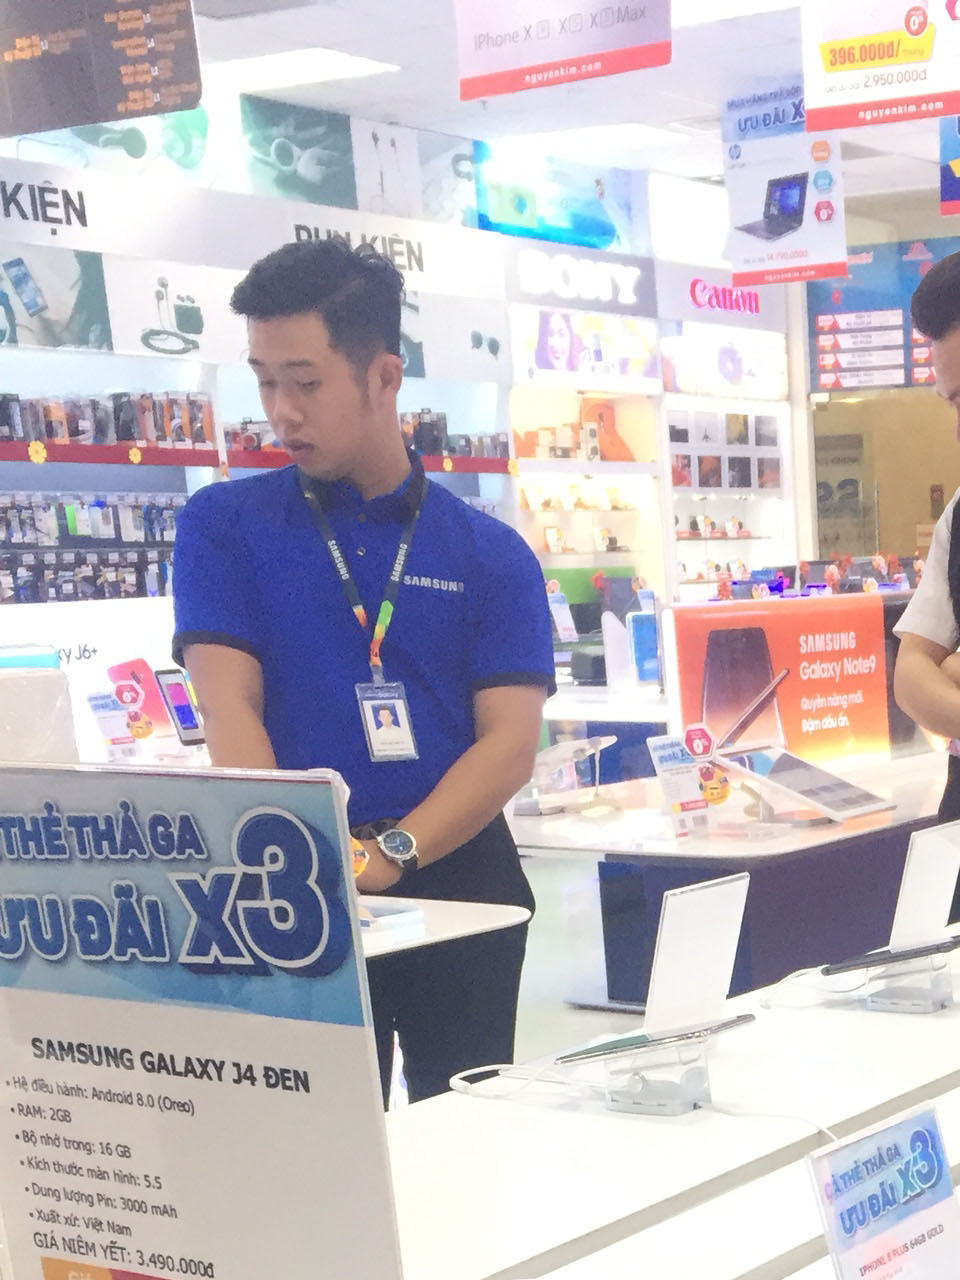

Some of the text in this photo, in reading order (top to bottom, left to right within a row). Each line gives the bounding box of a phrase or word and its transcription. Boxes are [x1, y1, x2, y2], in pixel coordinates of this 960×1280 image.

[474, 29, 519, 50] iPhone
[525, 61, 602, 83] nguyenkim.com
[858, 100, 944, 120] nguyenkim.com
[1, 180, 88, 236] KIỆN
[689, 277, 761, 315] Canon
[327, 539, 350, 581] SAMSUNG
[391, 543, 408, 582] SAMSUNG
[75, 643, 98, 661] J6+
[799, 631, 857, 655] SAMSUNG
[799, 654, 877, 683] Galaxy Note9
[2, 800, 207, 859] THẺ THẢ GA
[73, 880, 171, 962] ĐÃI
[31, 1037, 311, 1094] SAMSUNG GALAXY J4 ĐEN
[13, 1075, 195, 1117] Hệ điều hành: Android 8.0 (Oreo)
[17, 1103, 72, 1124] RAM: 2GB
[22, 1130, 132, 1159] Bộ nhớ trong: 16 GB
[27, 1156, 163, 1190] Kích thước màn hình: 5.5
[840, 1160, 864, 1191] THẺ
[862, 1147, 888, 1179] THẢ
[886, 1142, 902, 1163] GA
[31, 1182, 179, 1219] Dung lượng Pin: 3000 mAh
[839, 1205, 870, 1238] ƯU
[868, 1184, 898, 1221] ĐÃI
[36, 1208, 62, 1226] Xuất
[82, 1216, 104, 1234] Việt
[106, 1222, 133, 1237] Nam
[33, 1229, 215, 1279] GIÁ NIÊM YẾT: 3.490.000đ
[859, 1256, 887, 1277] IPHONE
[892, 1242, 910, 1261] PLUS
[909, 1232, 927, 1251] 64GB
[926, 1223, 945, 1240] GOLD
